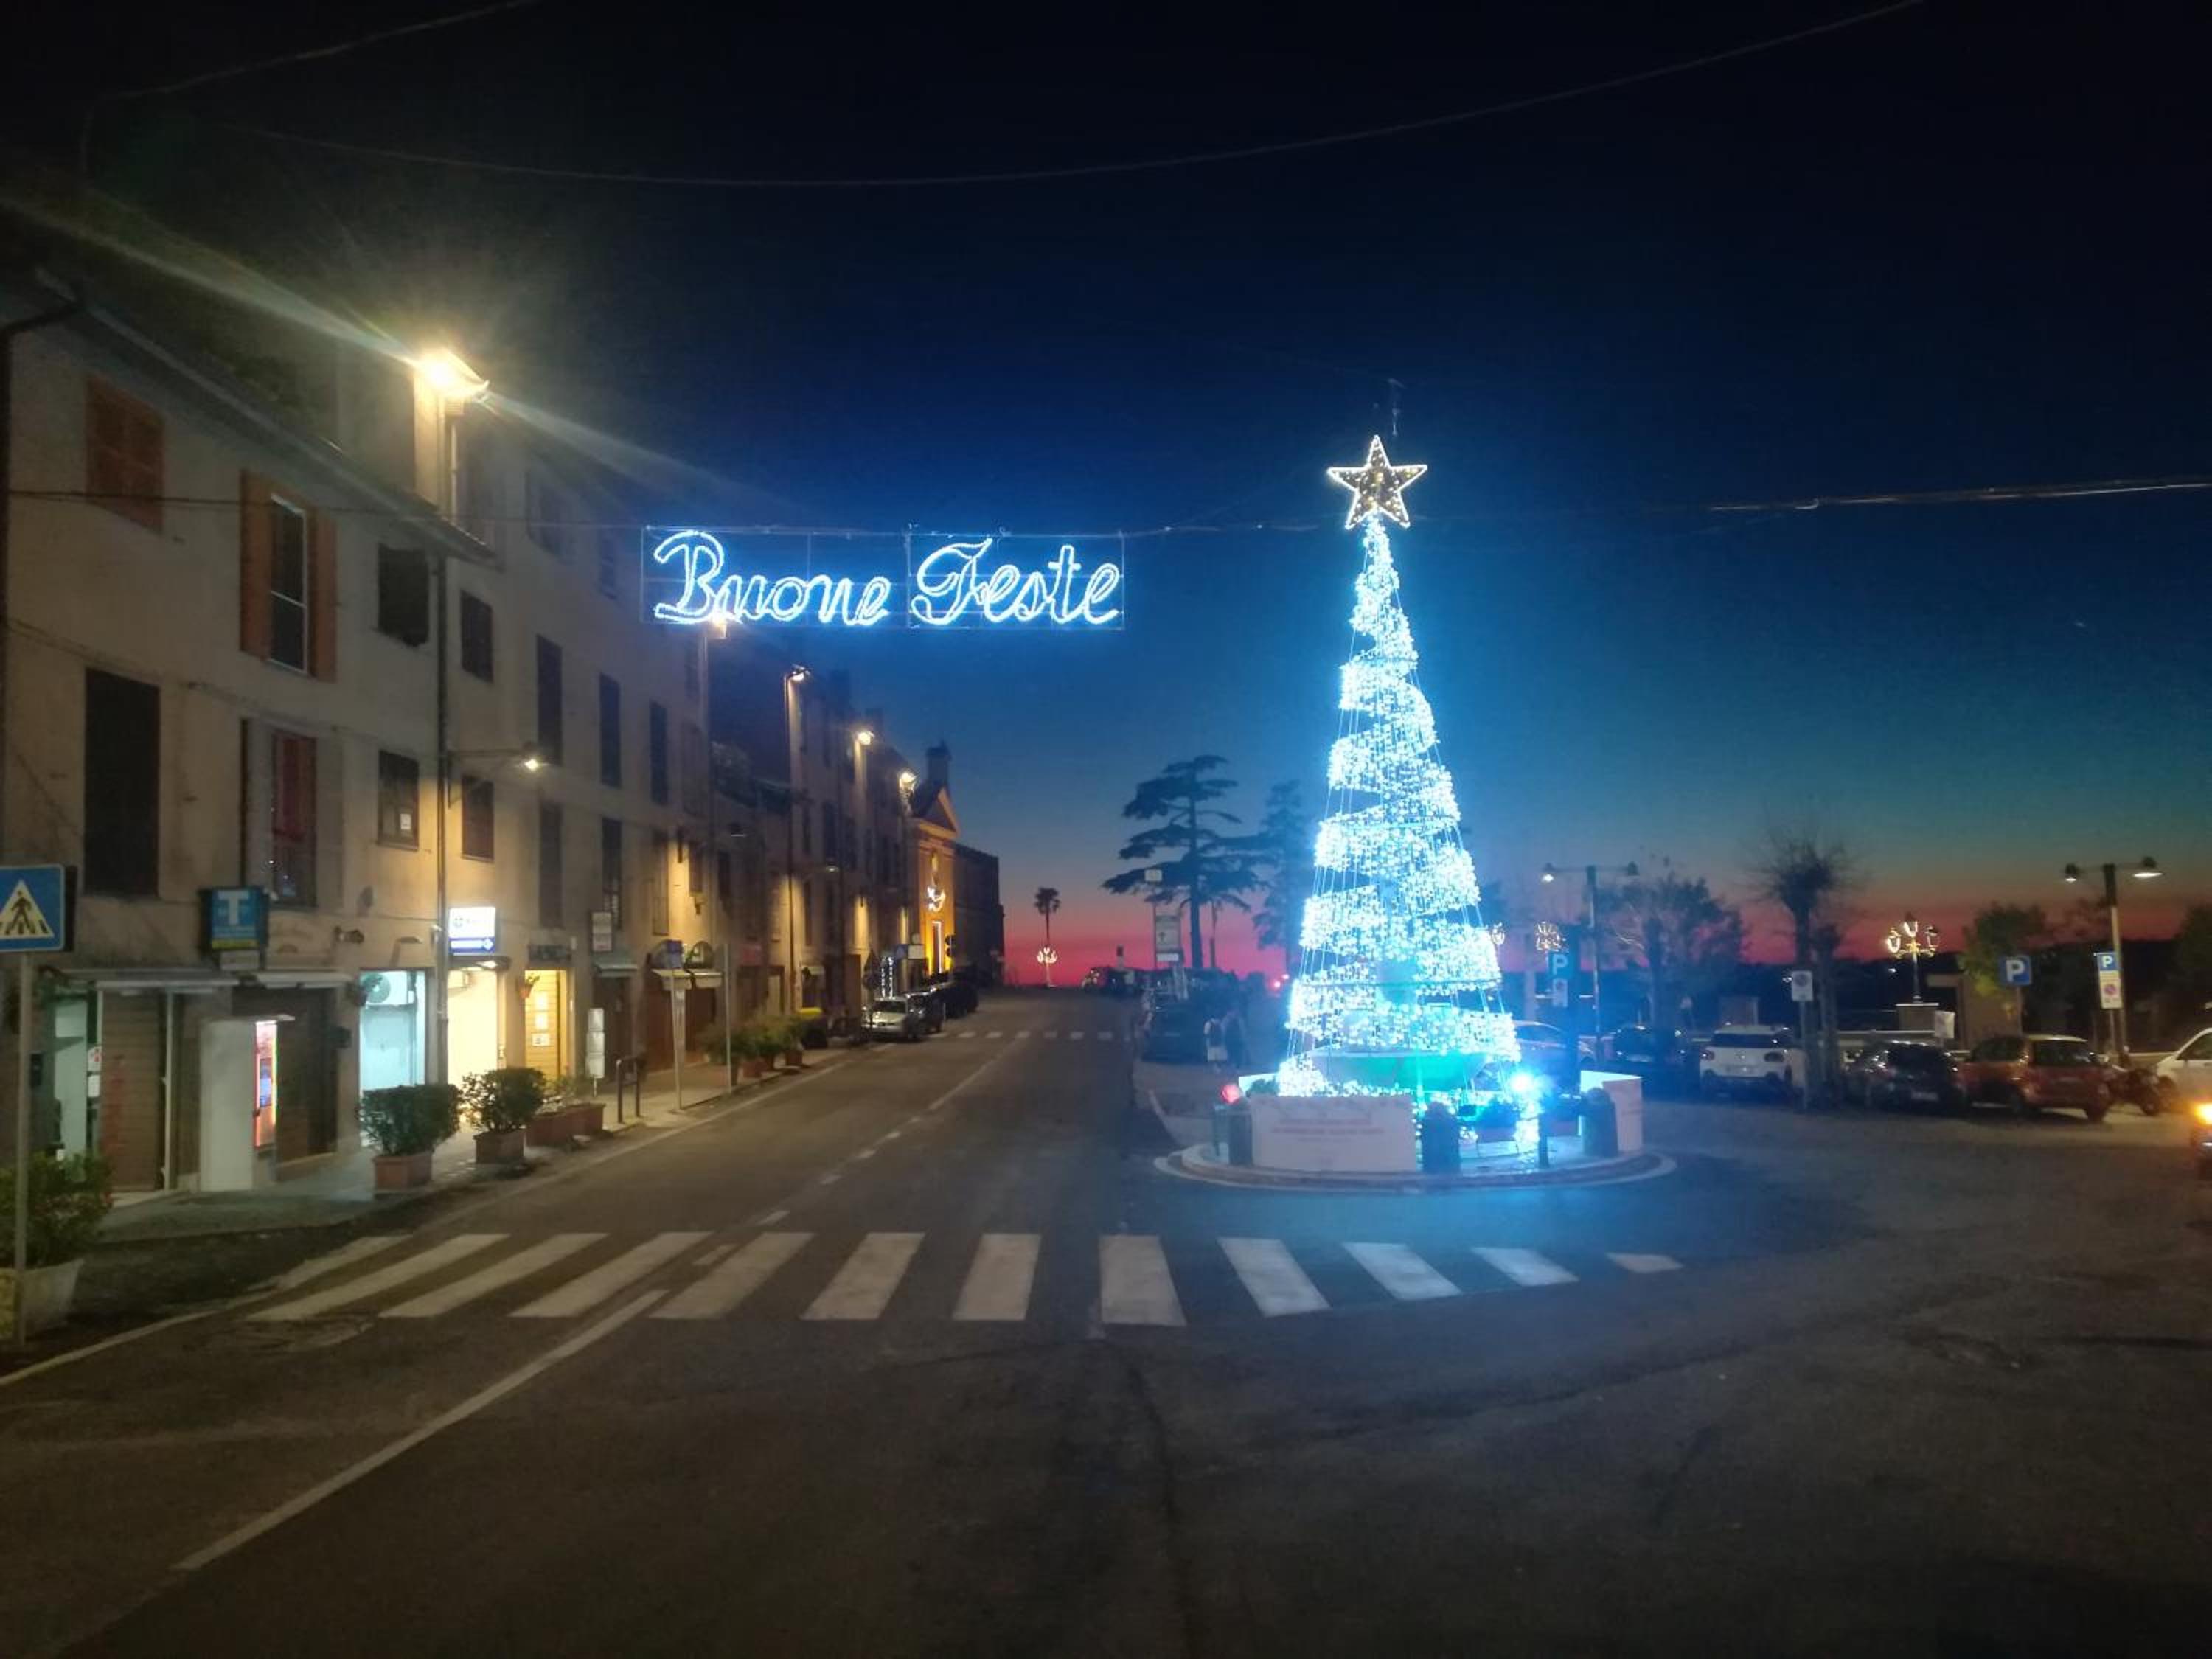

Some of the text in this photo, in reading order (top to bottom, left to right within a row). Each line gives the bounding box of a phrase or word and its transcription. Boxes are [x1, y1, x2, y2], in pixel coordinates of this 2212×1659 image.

[653, 529, 1119, 625] Buone Feste
[218, 890, 248, 925] T
[1552, 953, 1568, 975] P
[2006, 959, 2025, 982] P
[2102, 955, 2113, 968] P
